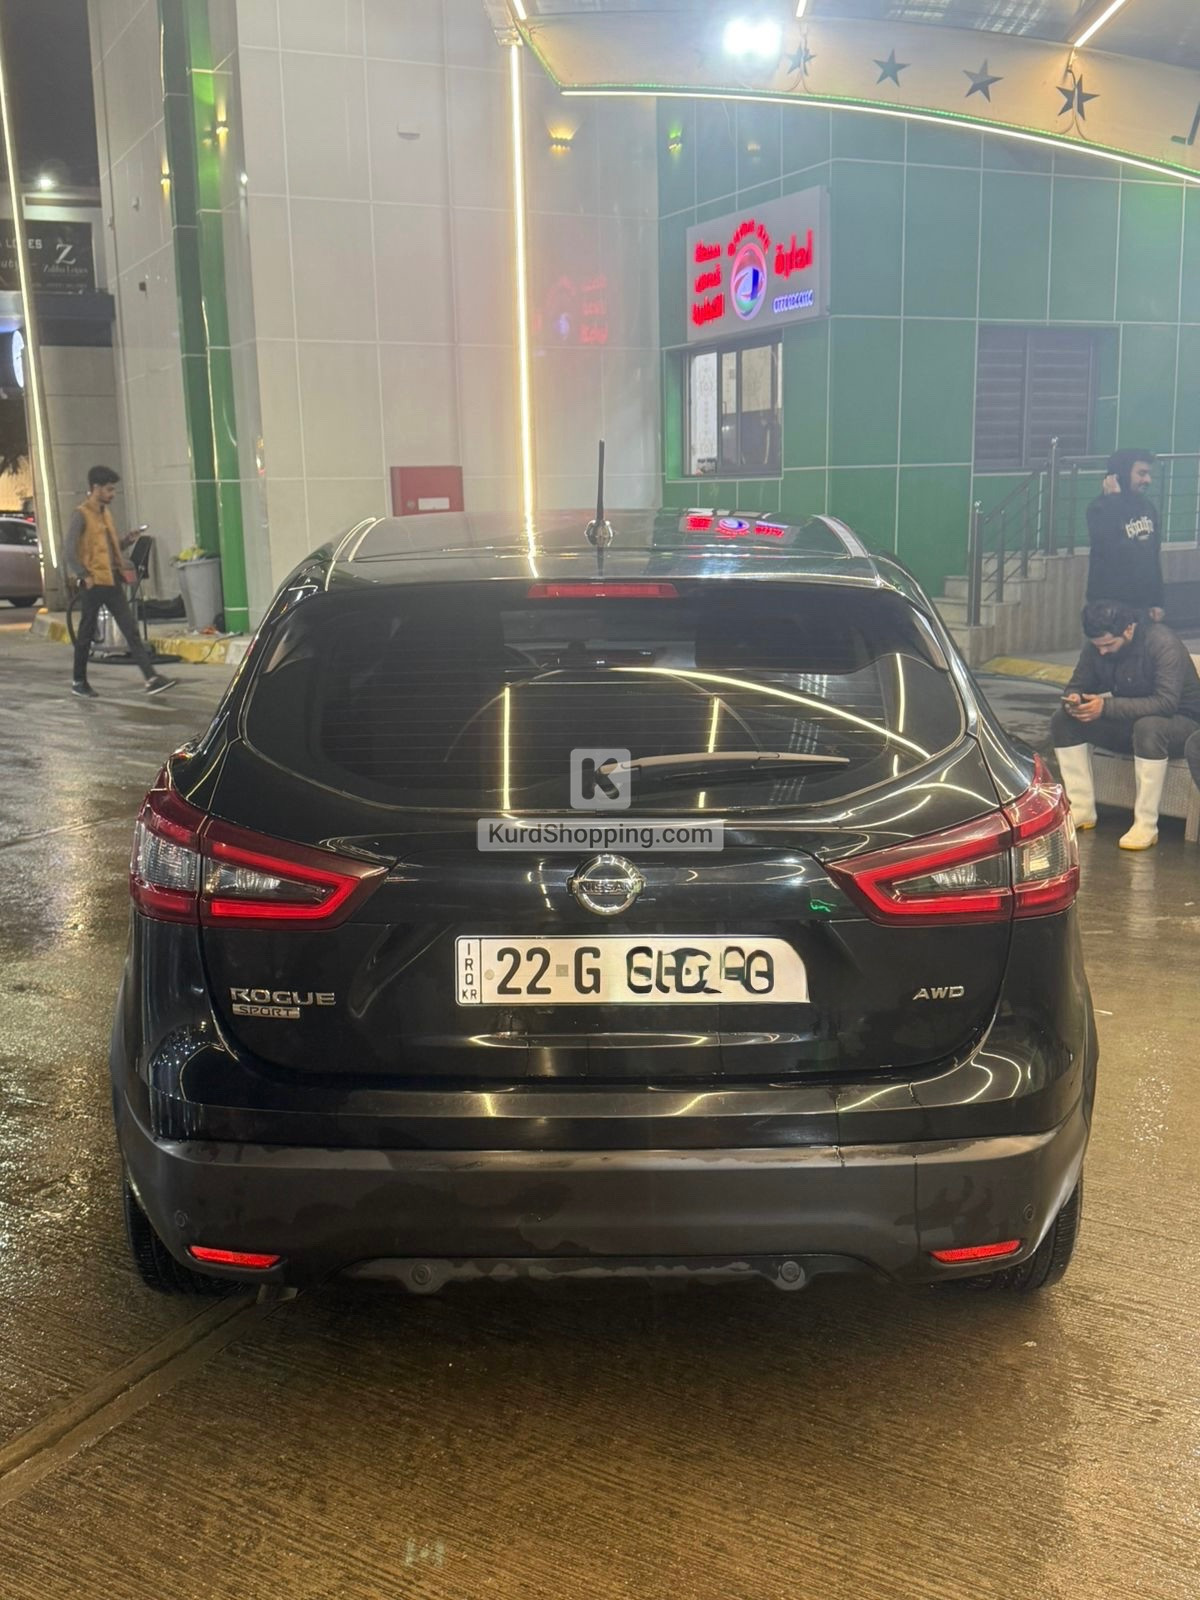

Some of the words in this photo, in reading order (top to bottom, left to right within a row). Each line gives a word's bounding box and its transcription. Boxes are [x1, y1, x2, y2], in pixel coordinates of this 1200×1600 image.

[580, 879, 635, 894] NISSAN
[497, 946, 552, 995] 22
[574, 946, 602, 995] G
[230, 987, 337, 1006] ROGUE
[461, 989, 478, 1000] KR
[912, 985, 965, 1001] AWD
[239, 1006, 293, 1017] SPORT
